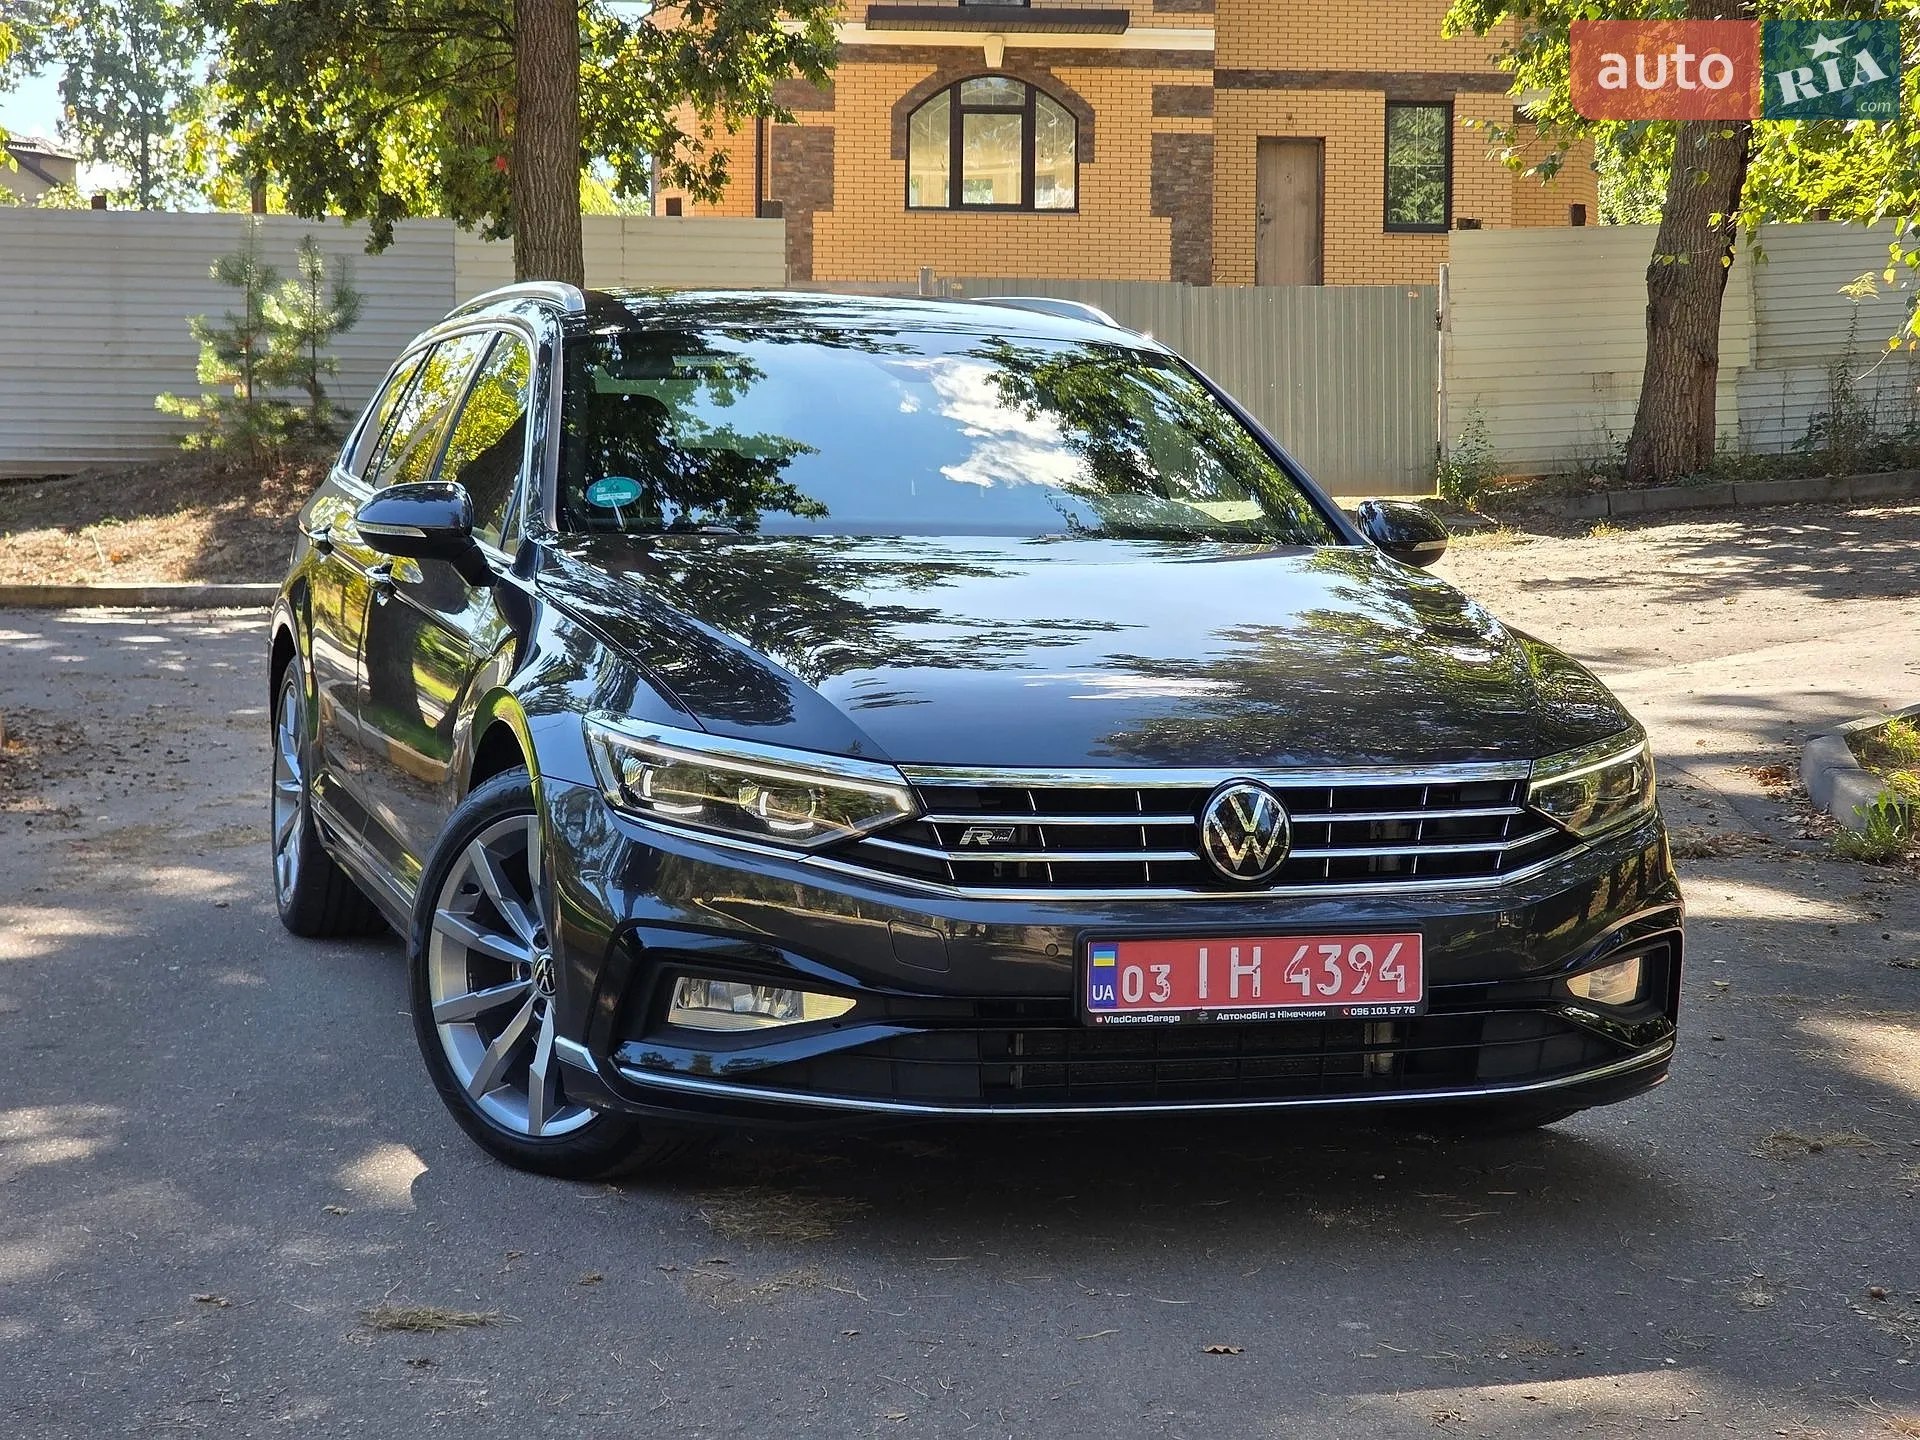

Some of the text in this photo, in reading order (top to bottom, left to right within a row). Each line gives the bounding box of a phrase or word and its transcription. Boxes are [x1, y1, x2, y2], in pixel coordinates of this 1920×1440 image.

[1122, 964, 1171, 1003] 03
[1284, 942, 1405, 997] 4394
[1092, 985, 1115, 1000] UA
[1350, 1005, 1416, 1016] 096 101 57 76
